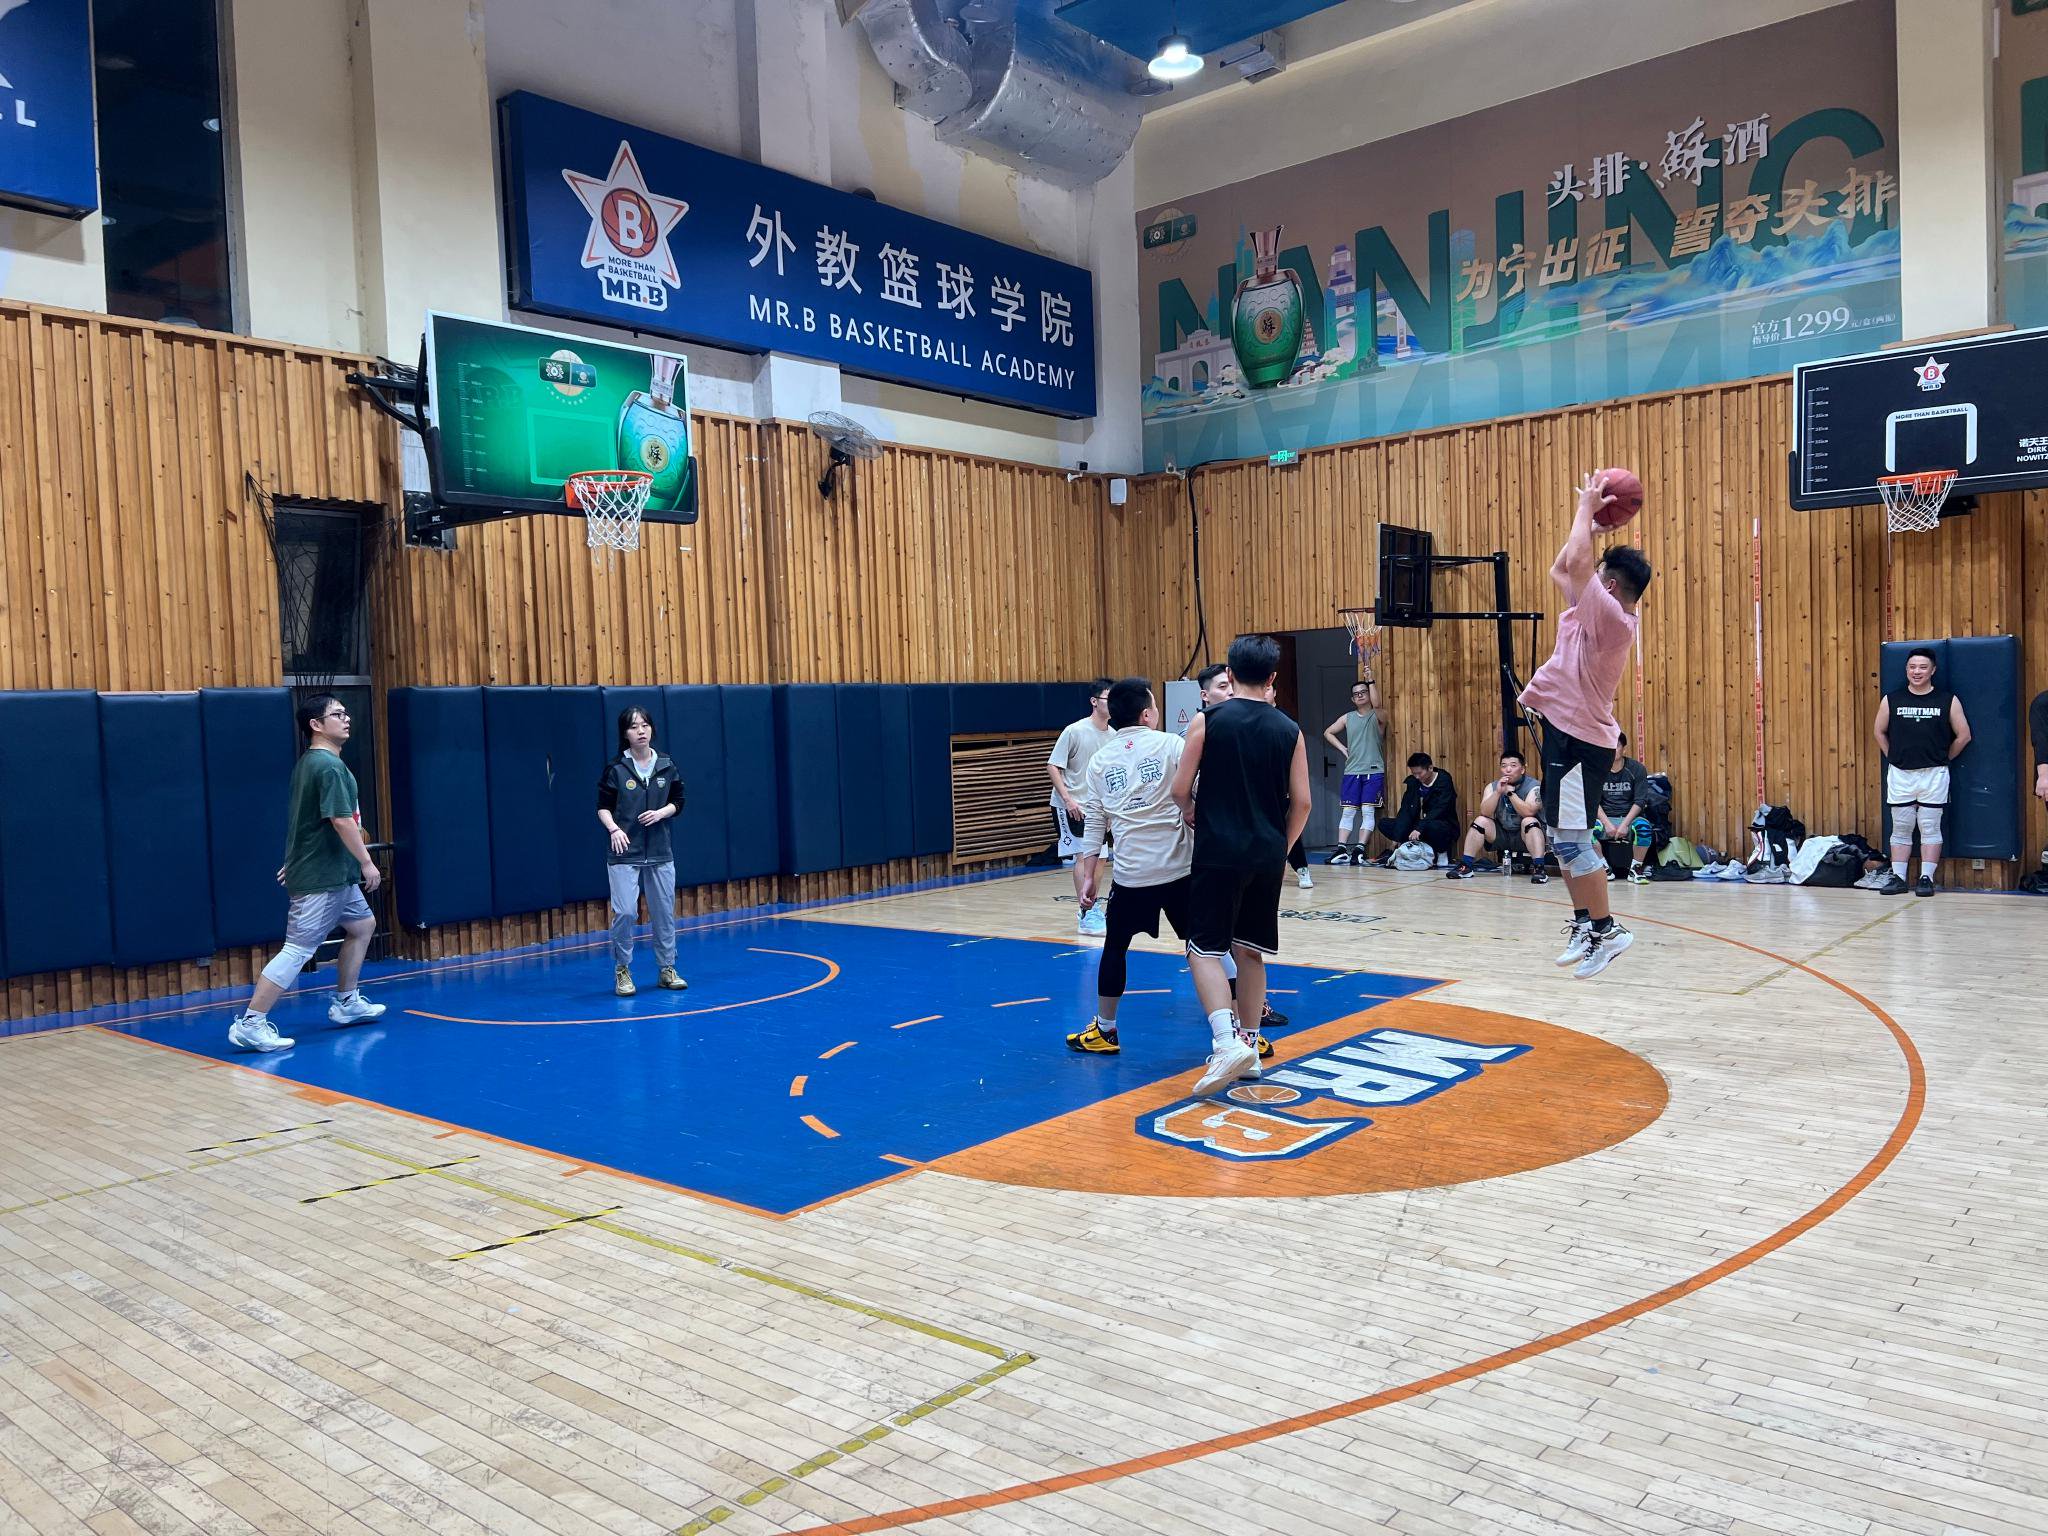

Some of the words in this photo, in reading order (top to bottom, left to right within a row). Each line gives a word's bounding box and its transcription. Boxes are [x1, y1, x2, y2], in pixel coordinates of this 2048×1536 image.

[617, 199, 644, 250] B
[1456, 225, 1629, 303] 为宁出征
[1668, 167, 1898, 259] 誓夺头排
[608, 255, 632, 269] MORE
[633, 260, 656, 274] THAN
[608, 266, 659, 284] BASKETBALL
[745, 203, 1075, 348] 外教篮球学院
[604, 276, 664, 307] MR.B
[1751, 319, 1780, 335] 官方
[1781, 306, 1851, 341] 1299
[749, 294, 817, 333] MR.B
[829, 313, 972, 369] BASKETBALL
[981, 350, 1076, 391] ACADEMY
[1895, 412, 1913, 420] MORE
[1914, 410, 1931, 418] THAN
[1931, 406, 1969, 416] BASKETBALL
[2027, 445, 2048, 454] DIRK
[1896, 706, 1941, 717] COURTMAN
[1104, 757, 1163, 793] 南京
